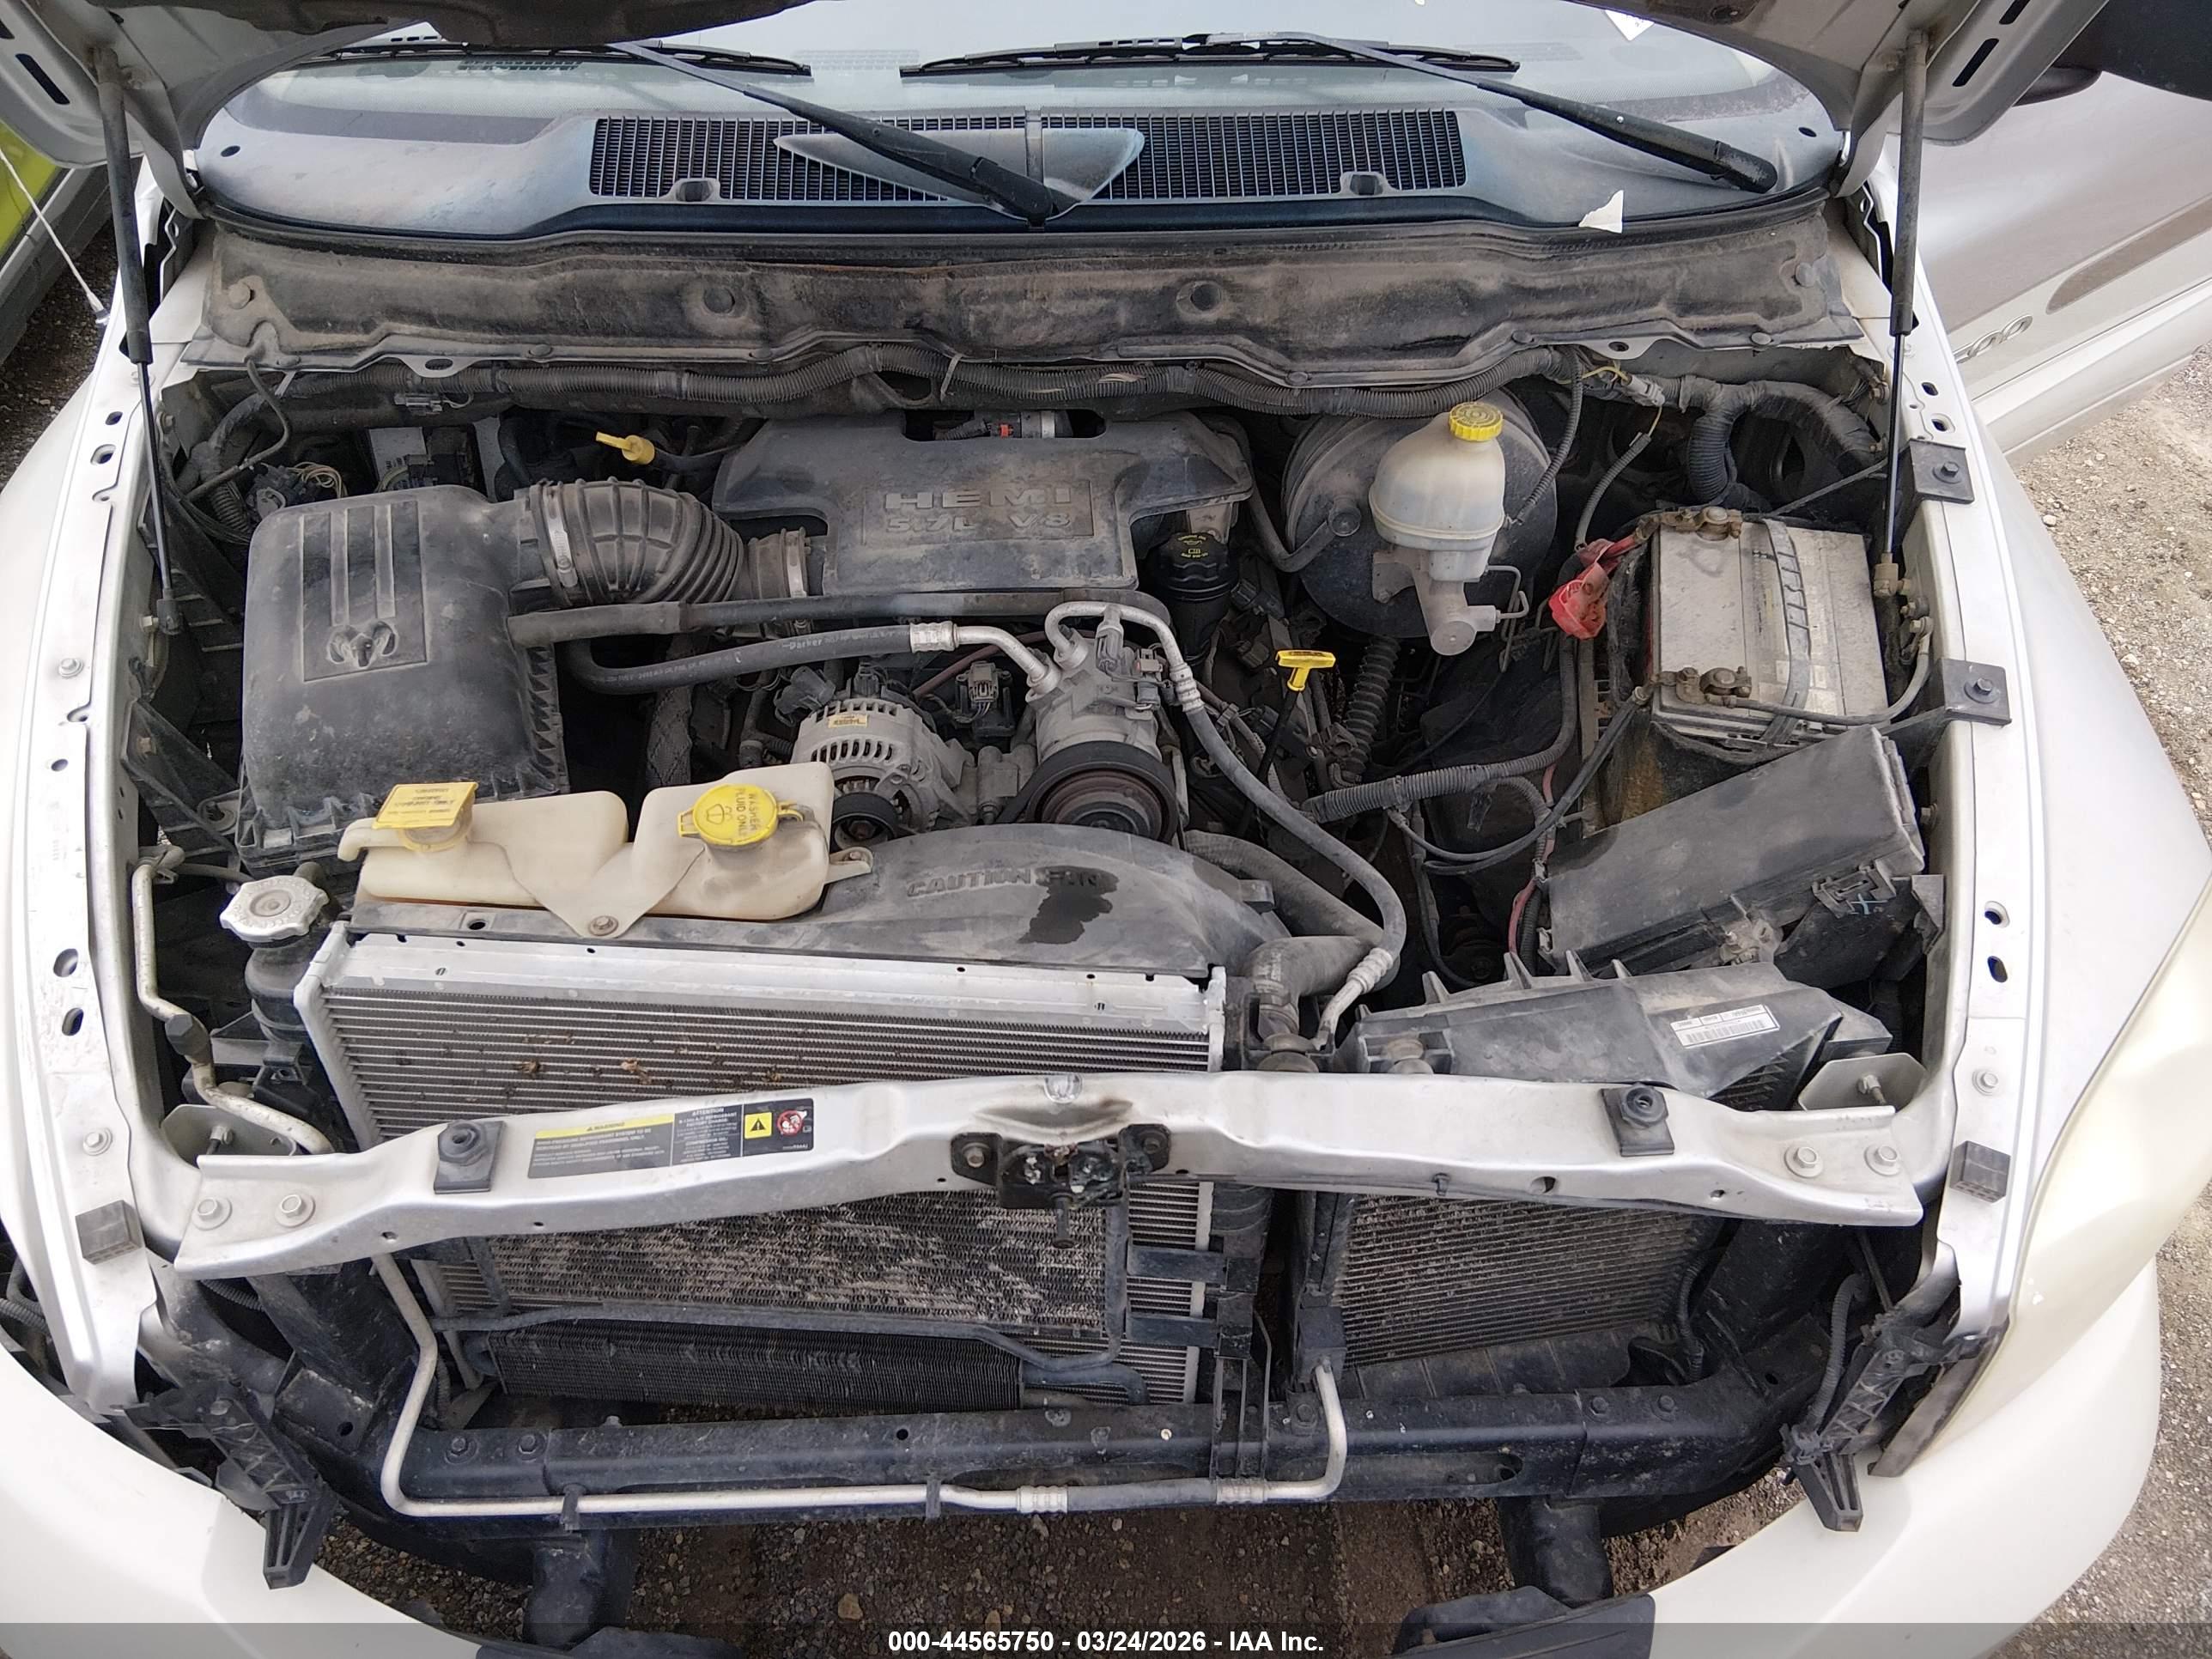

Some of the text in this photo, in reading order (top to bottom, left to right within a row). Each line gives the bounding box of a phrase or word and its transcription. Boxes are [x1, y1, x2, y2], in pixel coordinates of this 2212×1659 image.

[884, 488, 1071, 509] HEMI
[886, 514, 1071, 533] 5.7L V8
[789, 638, 823, 650] Parker
[748, 793, 759, 831] WASHER
[907, 867, 1031, 897] CAUTION
